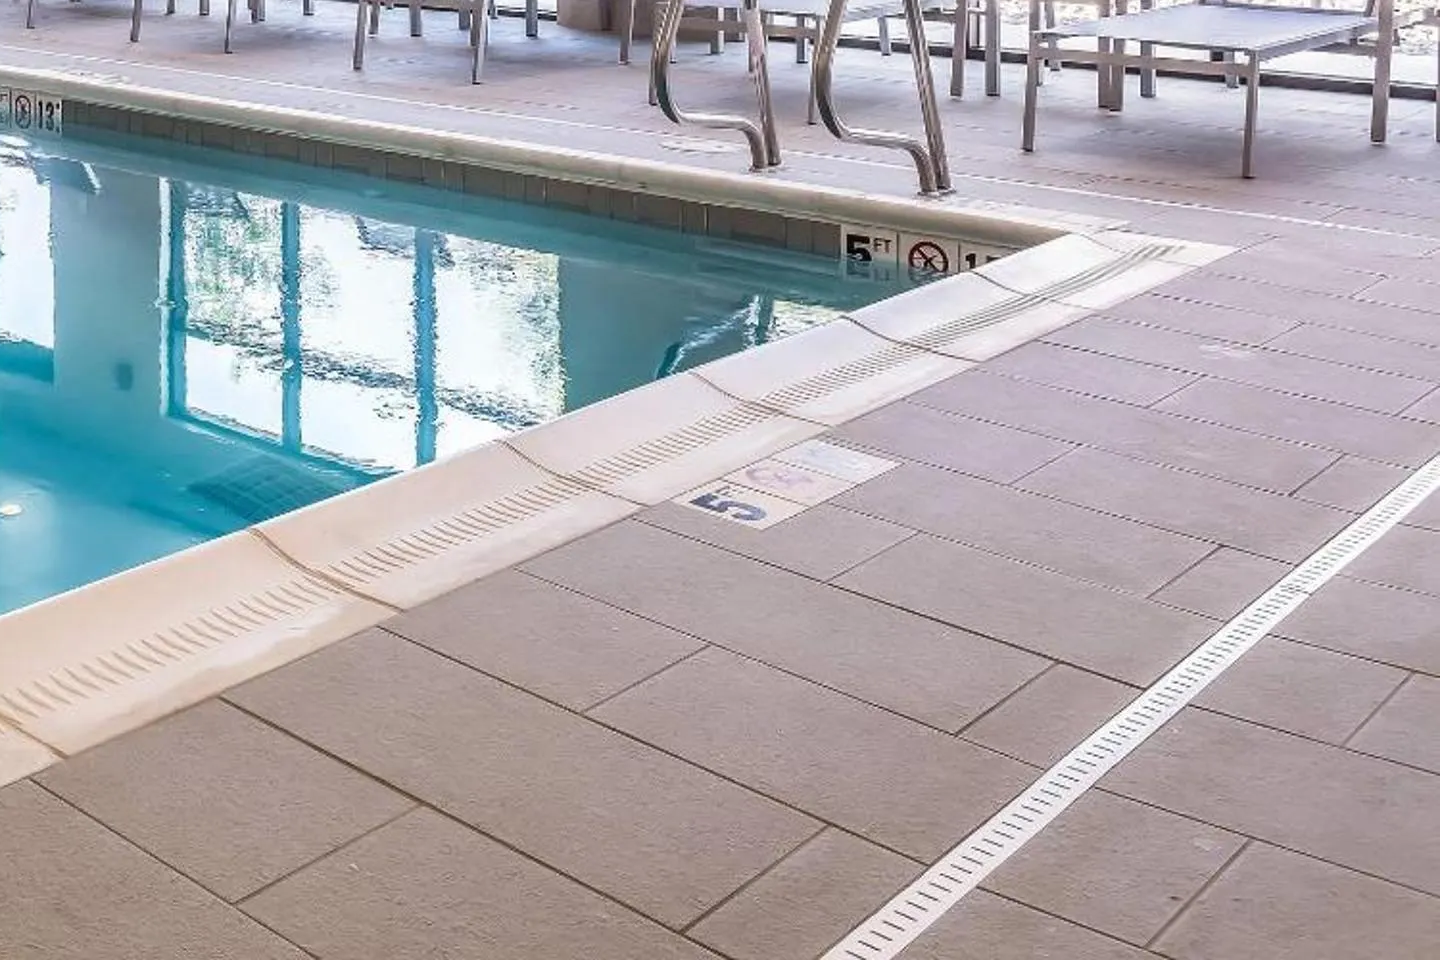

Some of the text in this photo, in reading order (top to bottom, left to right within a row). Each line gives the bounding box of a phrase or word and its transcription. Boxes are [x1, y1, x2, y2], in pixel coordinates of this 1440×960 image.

[846, 234, 892, 262] 5 FT
[689, 493, 767, 521] 5
